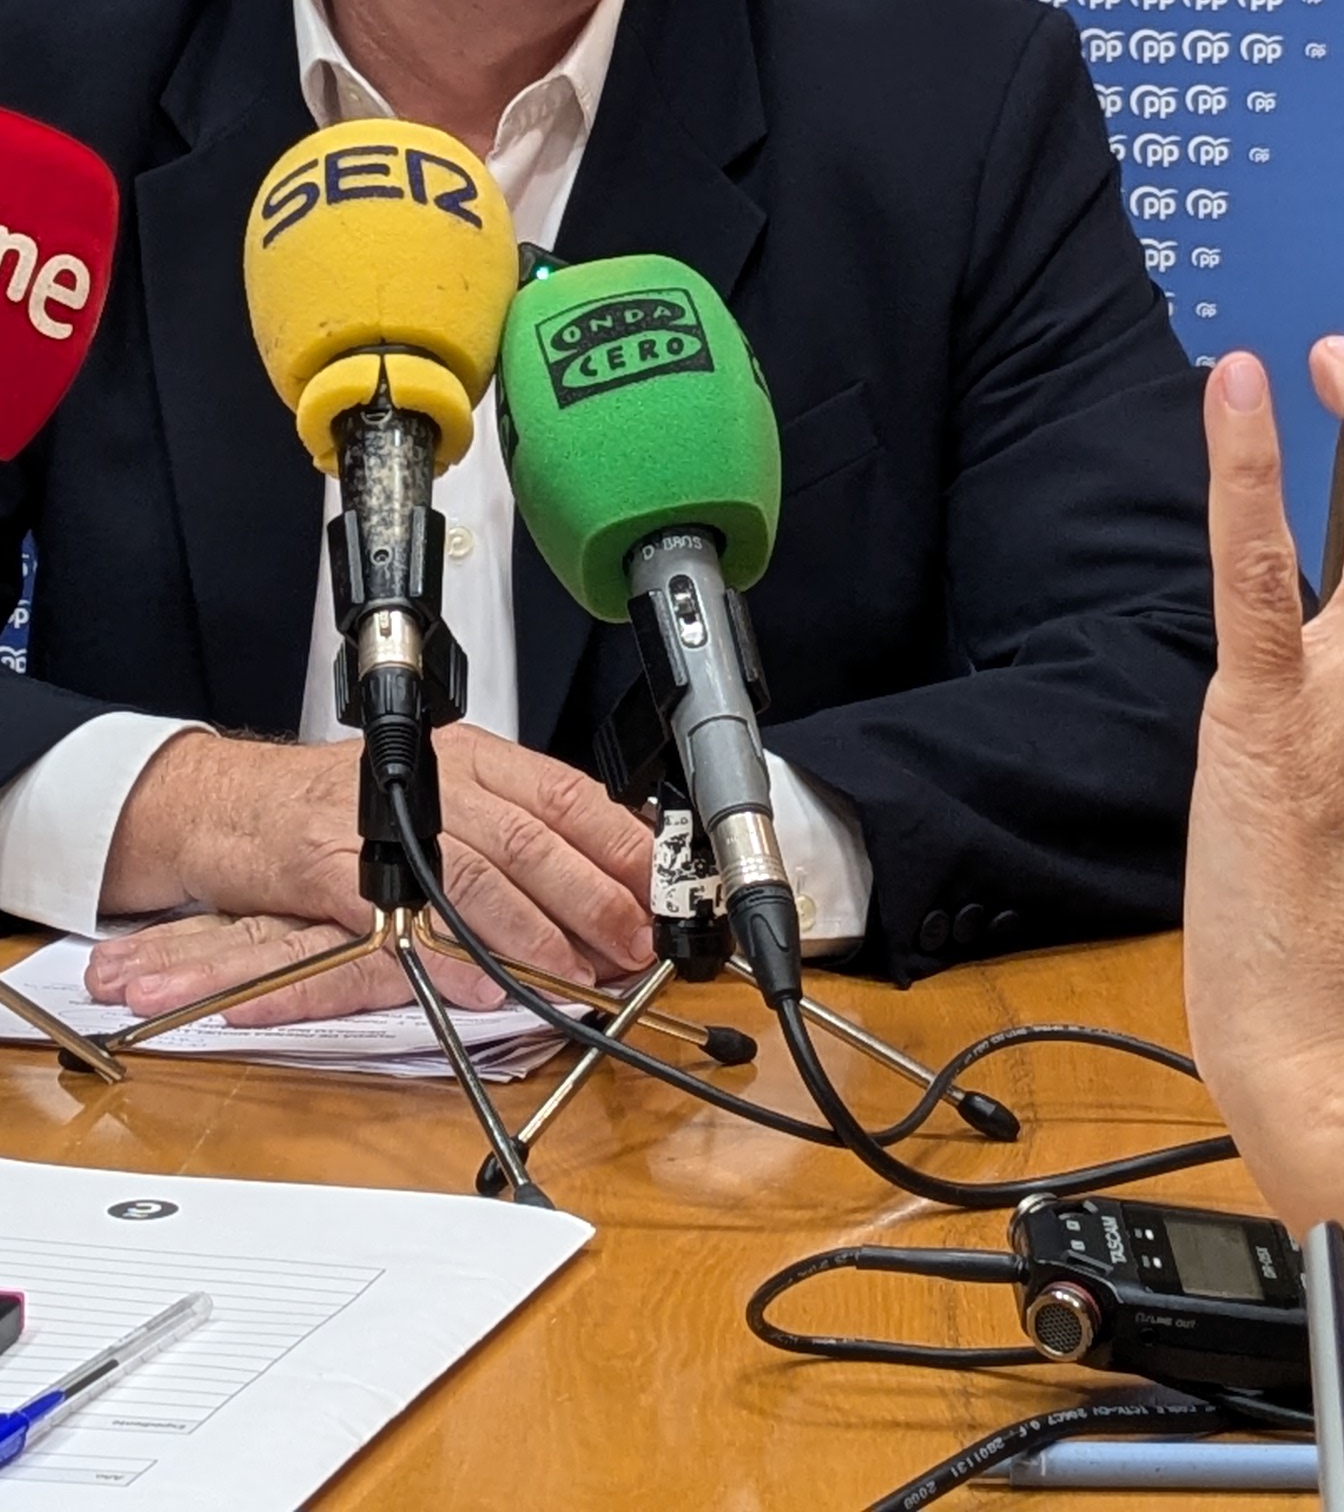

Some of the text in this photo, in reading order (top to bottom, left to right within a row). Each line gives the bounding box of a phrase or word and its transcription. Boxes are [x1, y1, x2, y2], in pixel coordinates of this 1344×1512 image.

[260, 145, 483, 250] SER
[562, 304, 674, 344] ONDA
[578, 334, 686, 378] CERO
[1100, 1215, 1128, 1265] TASCAM
